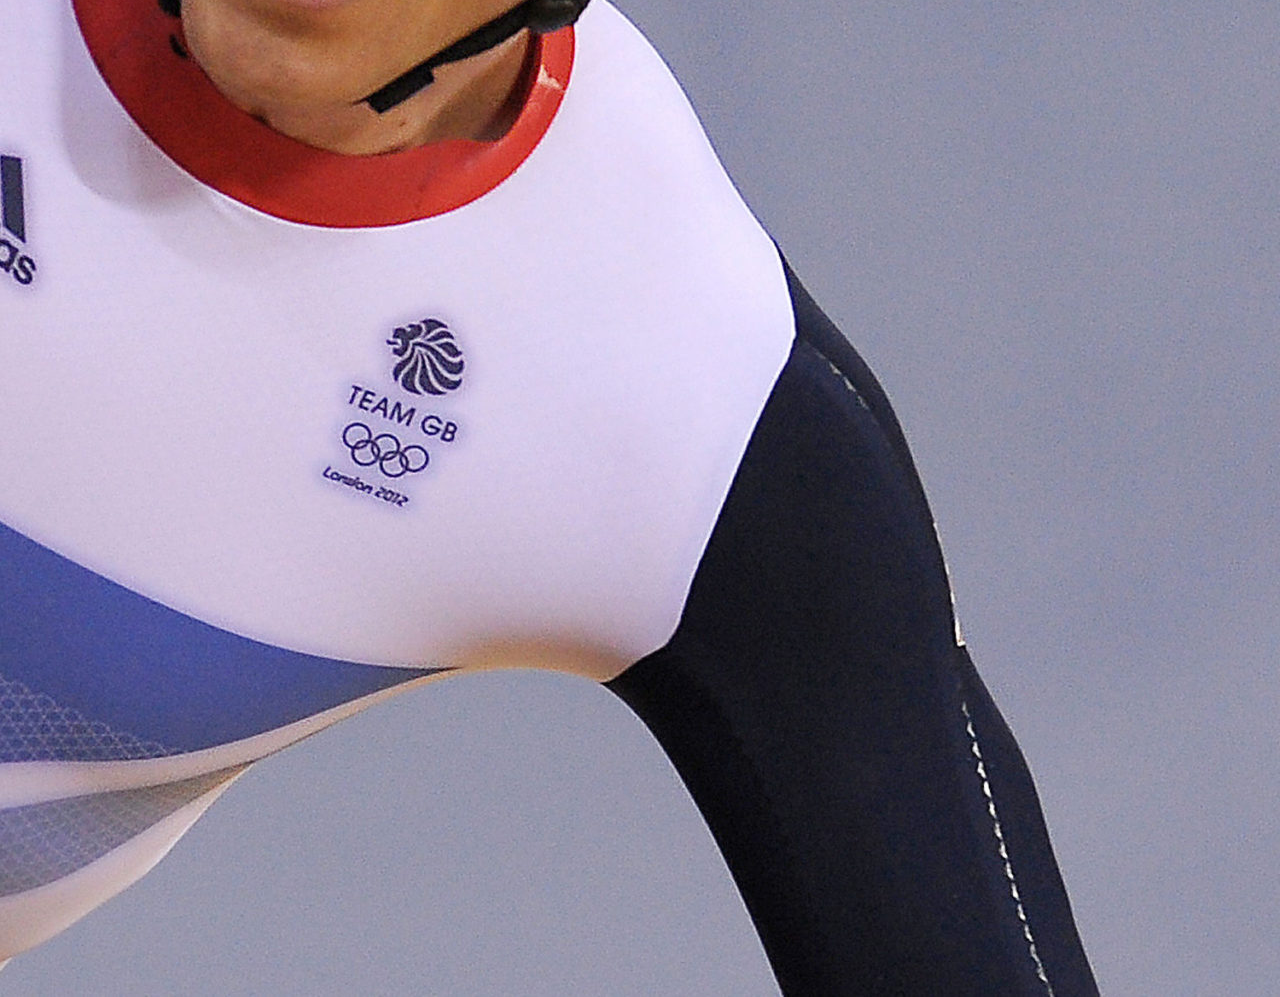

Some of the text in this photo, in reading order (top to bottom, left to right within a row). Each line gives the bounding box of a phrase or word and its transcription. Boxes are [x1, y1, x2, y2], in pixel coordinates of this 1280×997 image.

[348, 384, 458, 443] TEAM GB
[322, 465, 410, 507] London 2012
